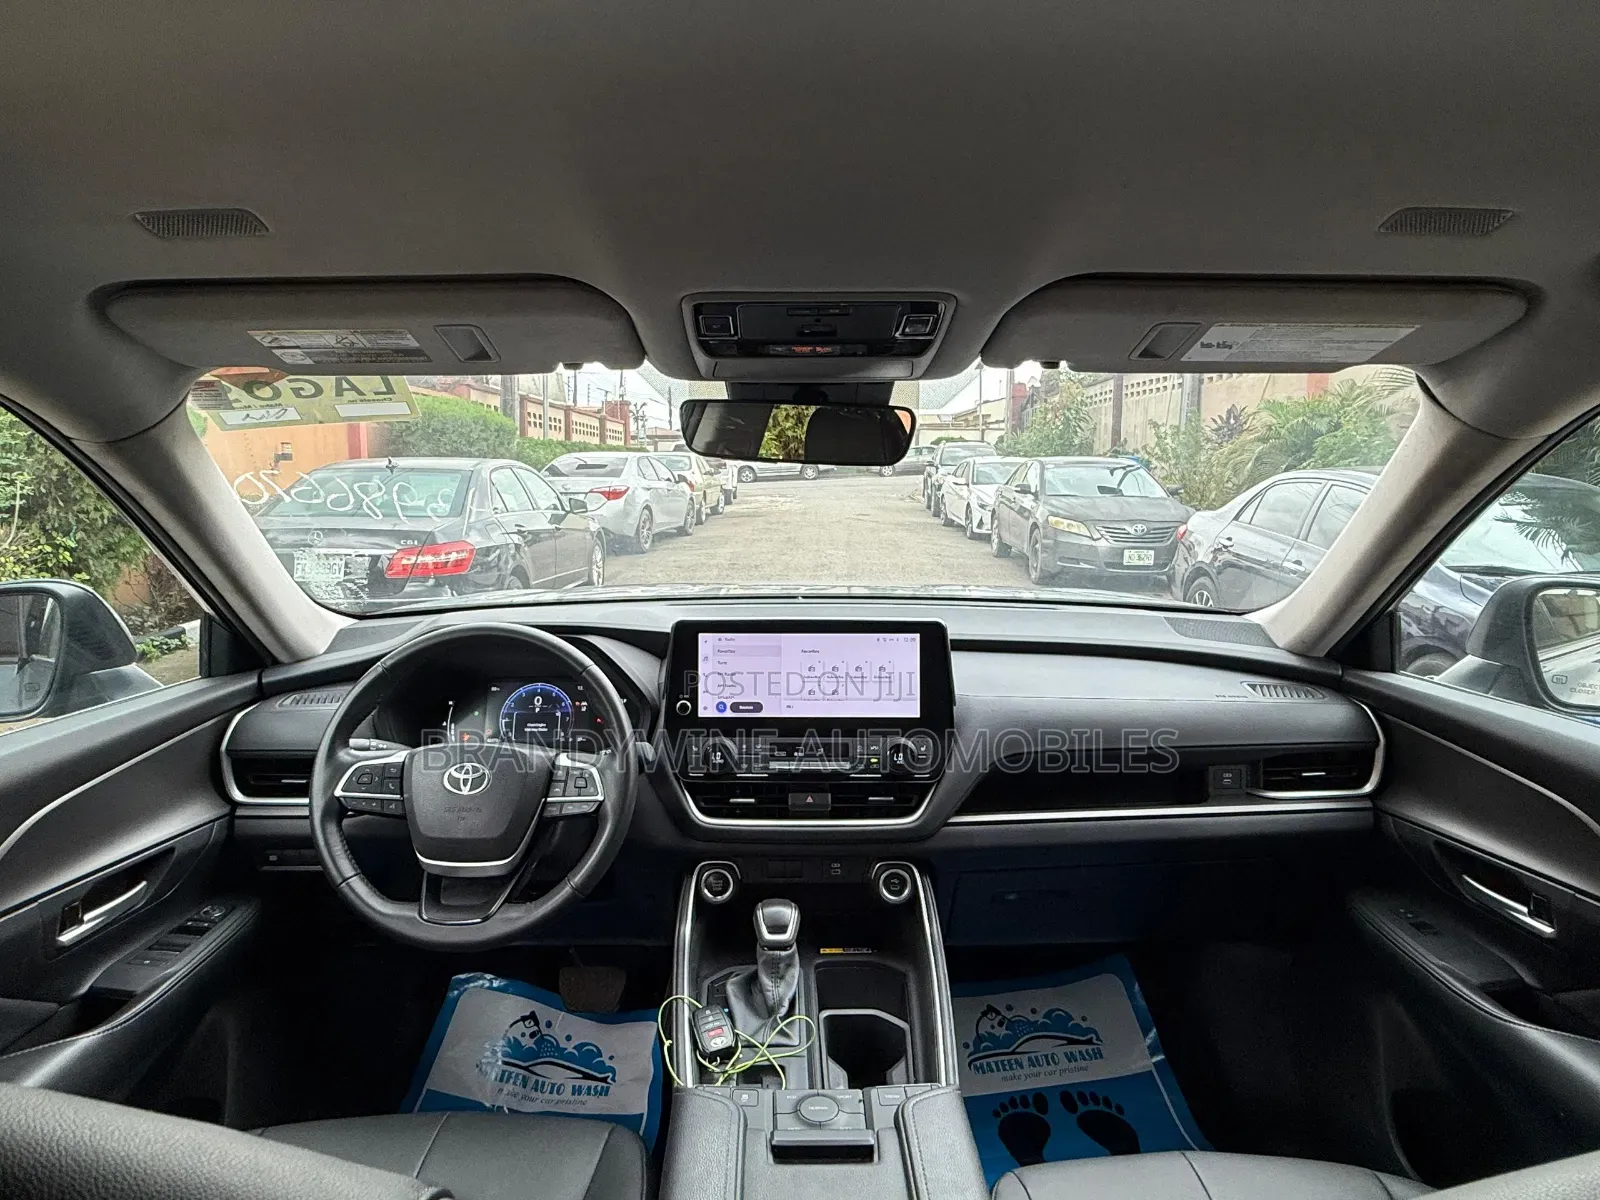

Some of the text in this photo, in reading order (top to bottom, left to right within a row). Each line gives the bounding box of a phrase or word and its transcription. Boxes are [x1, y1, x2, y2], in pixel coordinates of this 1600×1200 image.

[972, 1046, 1104, 1075] MATEEN AUTO WASH
[1001, 1065, 1089, 1081] make your car pristine
[482, 1067, 611, 1097] TEEN AUTO WASH
